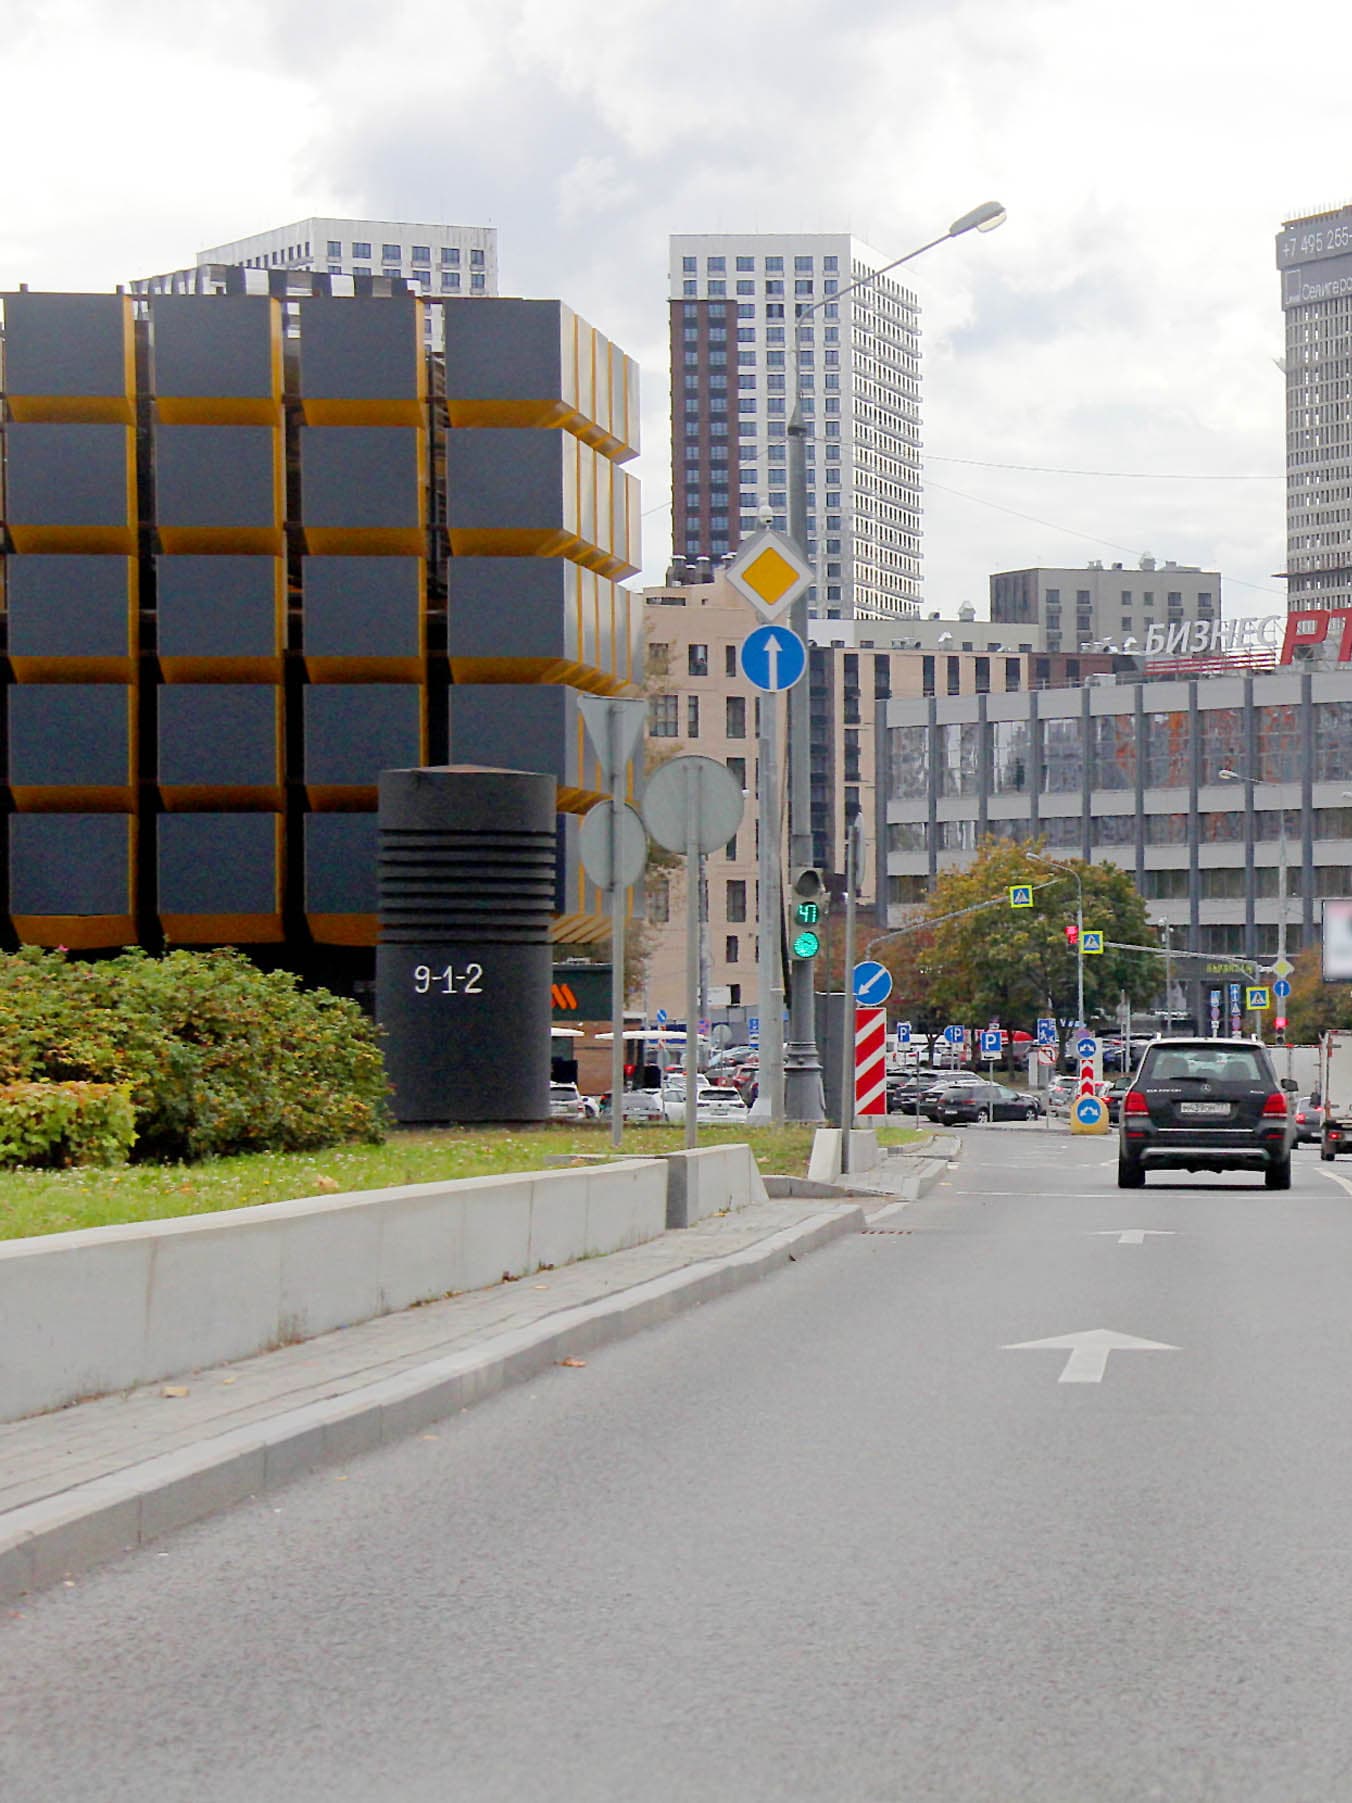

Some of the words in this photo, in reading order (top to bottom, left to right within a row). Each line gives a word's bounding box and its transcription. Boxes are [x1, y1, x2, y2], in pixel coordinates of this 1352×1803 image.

[1283, 237, 1297, 257] +7
[1300, 232, 1323, 254] 495
[1144, 615, 1281, 656] БИЗНЕС
[414, 963, 483, 994] 9-1-2
[985, 1033, 997, 1050] P
